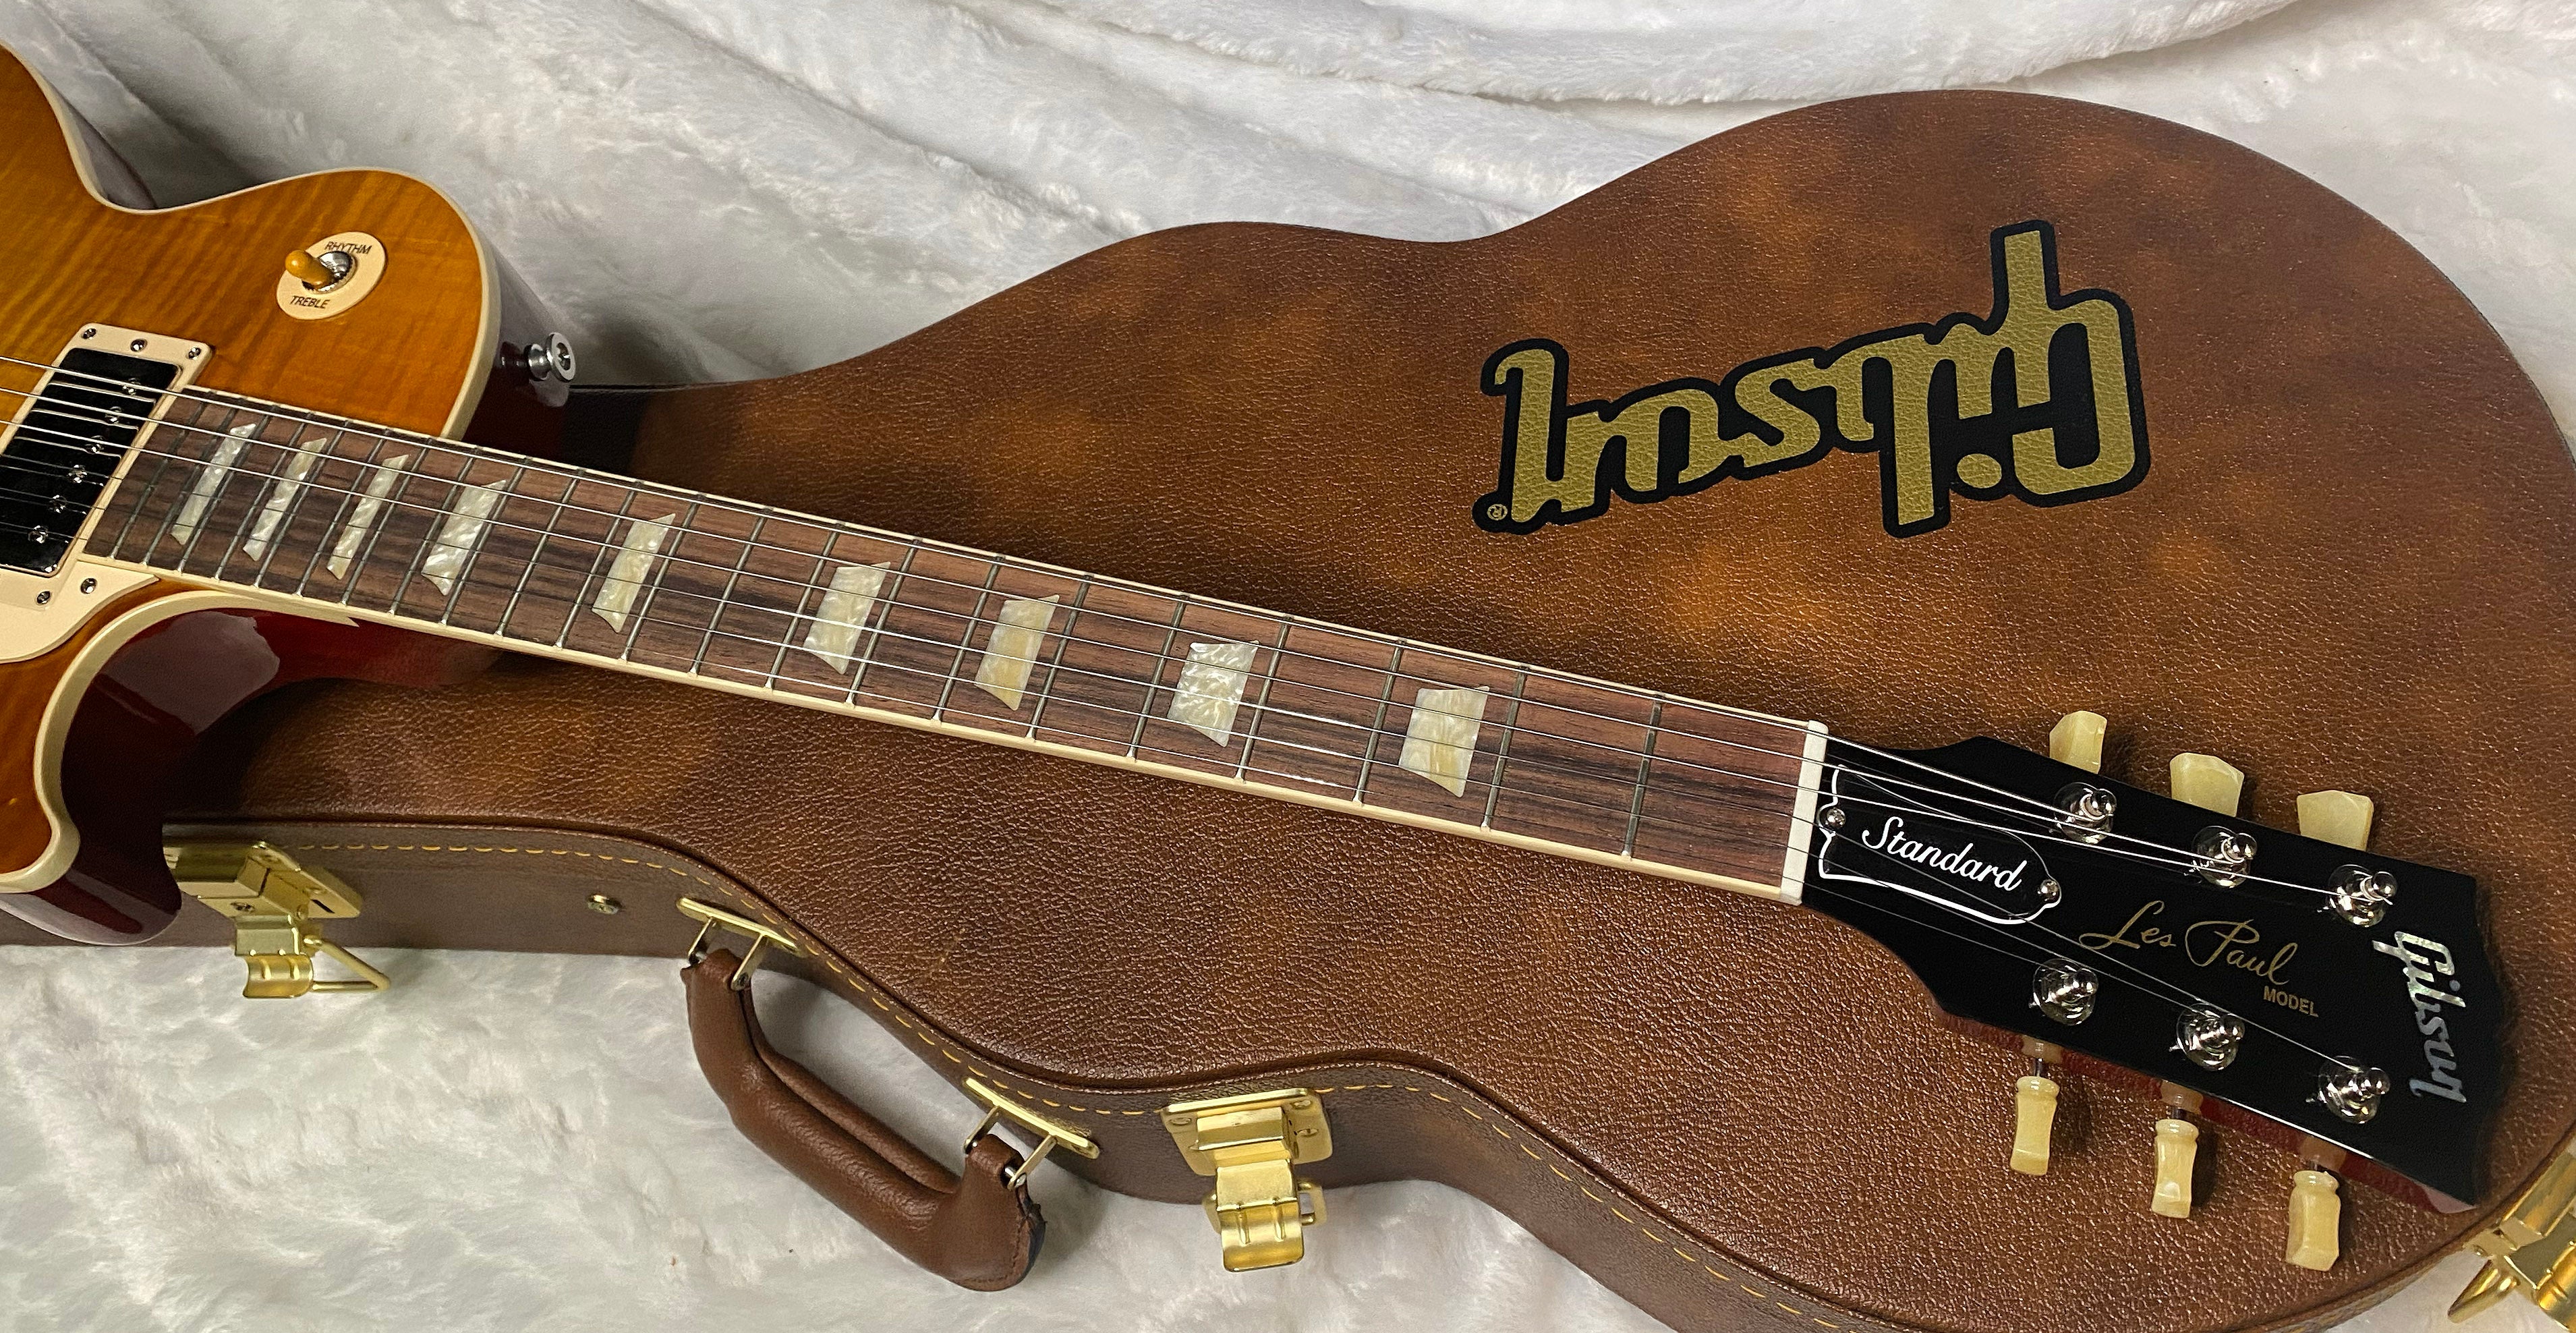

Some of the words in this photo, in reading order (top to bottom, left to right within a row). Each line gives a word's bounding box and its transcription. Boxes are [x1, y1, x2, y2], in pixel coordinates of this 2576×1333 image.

[324, 241, 372, 255] RHYTHM
[289, 295, 331, 309] TREBLE
[1862, 816, 2028, 892] Standard
[2078, 899, 2177, 951] Les
[2185, 919, 2298, 986] Paul
[2262, 985, 2319, 1018] MODEL
[2371, 930, 2467, 1104] Gibson
